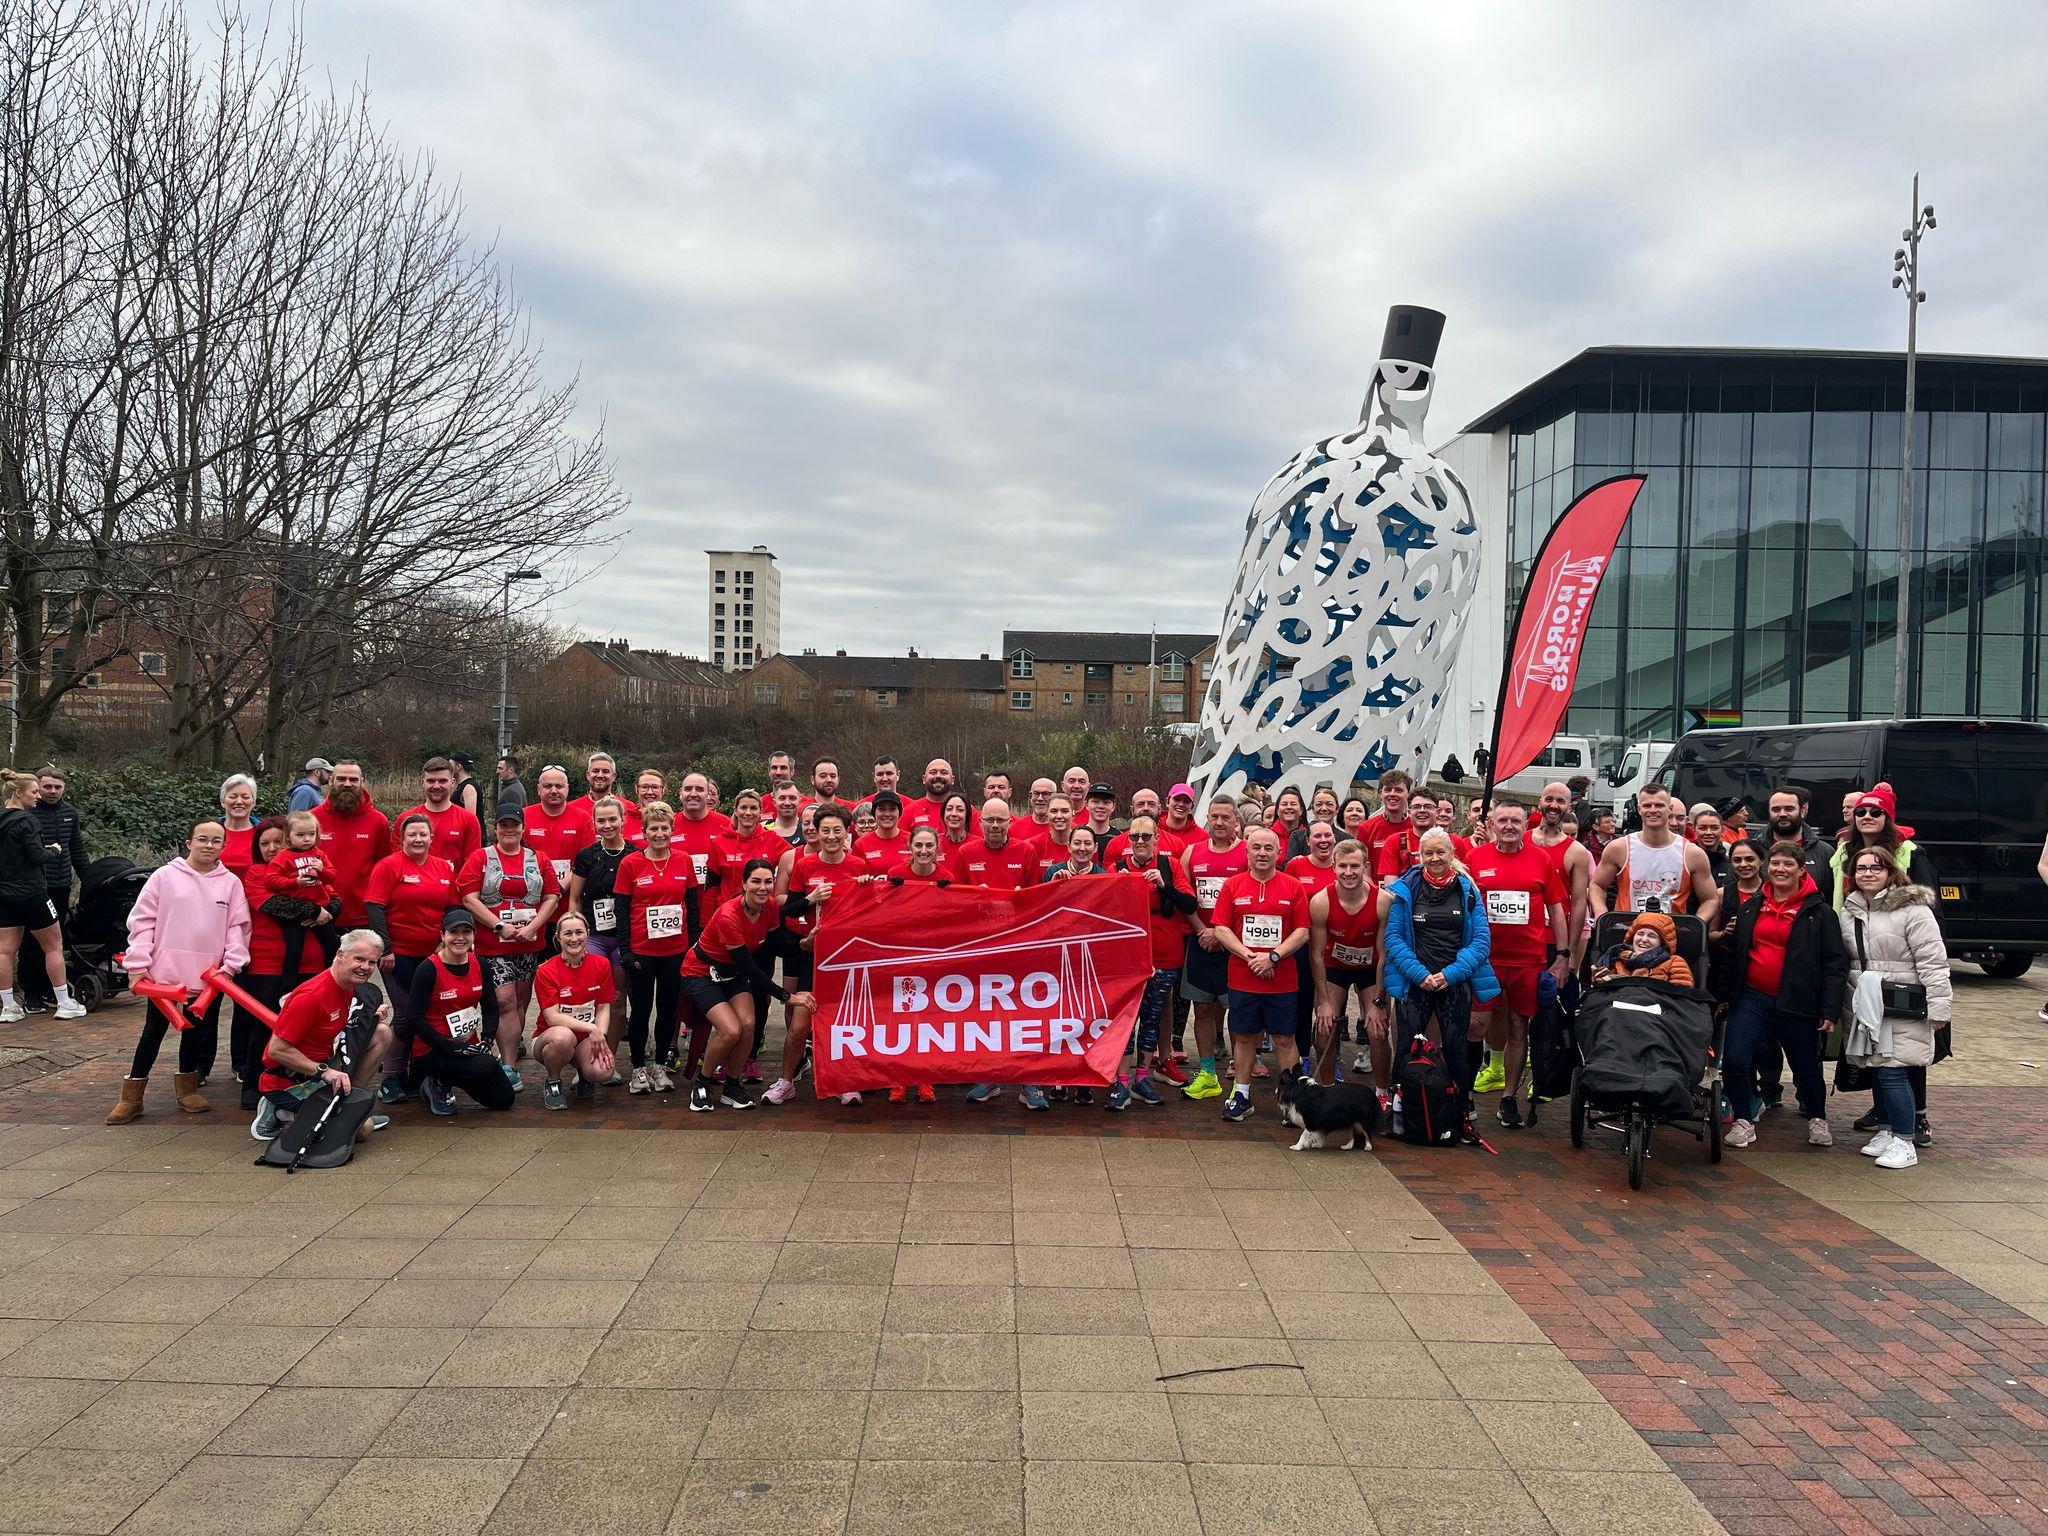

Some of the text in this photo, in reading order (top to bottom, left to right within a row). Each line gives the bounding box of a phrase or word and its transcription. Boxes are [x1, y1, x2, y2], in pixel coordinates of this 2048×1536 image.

[1490, 903, 1527, 915] 4054
[651, 916, 680, 929] 6720
[1246, 926, 1279, 938] 4984
[1336, 950, 1369, 965] 5841
[892, 971, 1060, 1013] BORO
